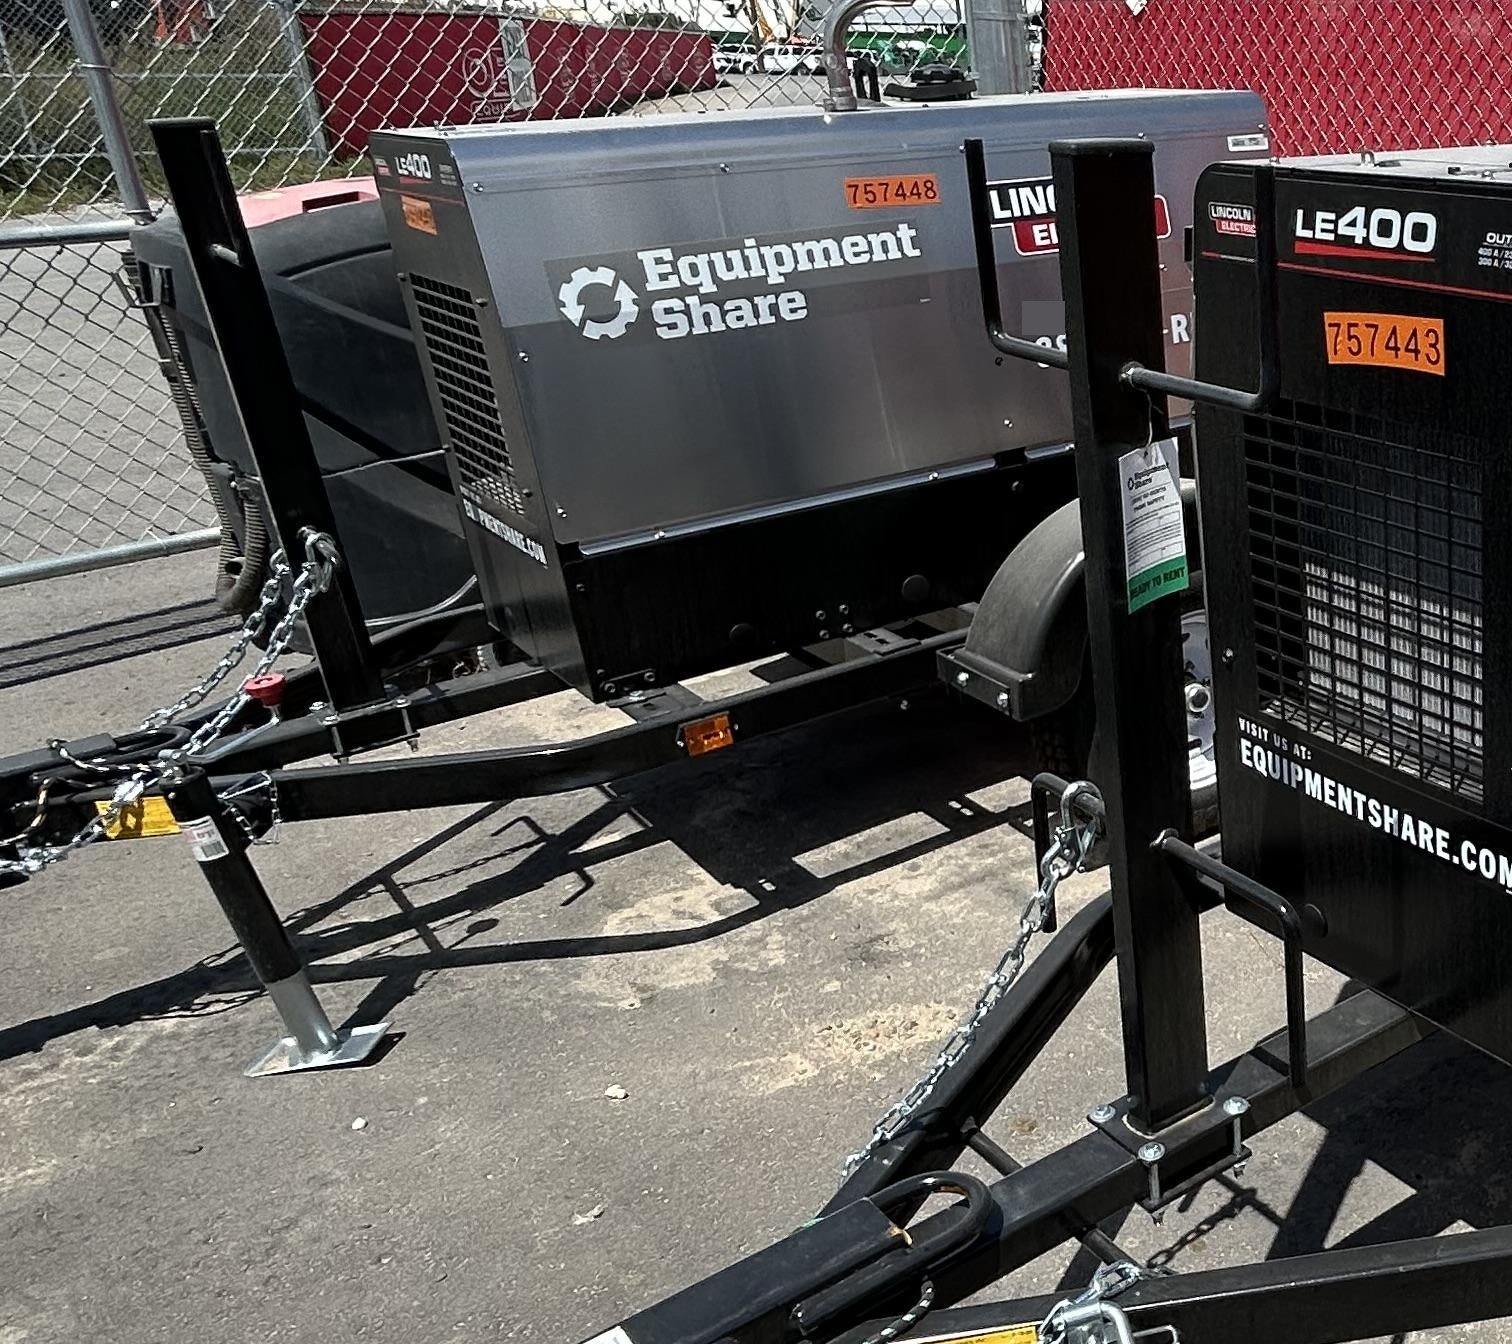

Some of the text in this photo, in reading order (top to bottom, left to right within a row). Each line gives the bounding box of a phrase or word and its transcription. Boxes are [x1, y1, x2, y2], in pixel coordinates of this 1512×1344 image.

[847, 179, 938, 205] 757448
[1210, 205, 1251, 221] LINCOLN
[1295, 206, 1437, 253] LE400
[636, 222, 922, 295] Equipment
[650, 289, 809, 340] Share
[1327, 322, 1441, 366] 757443
[1163, 567, 1186, 583] RENT
[1238, 716, 1312, 761] VISIT US AT:
